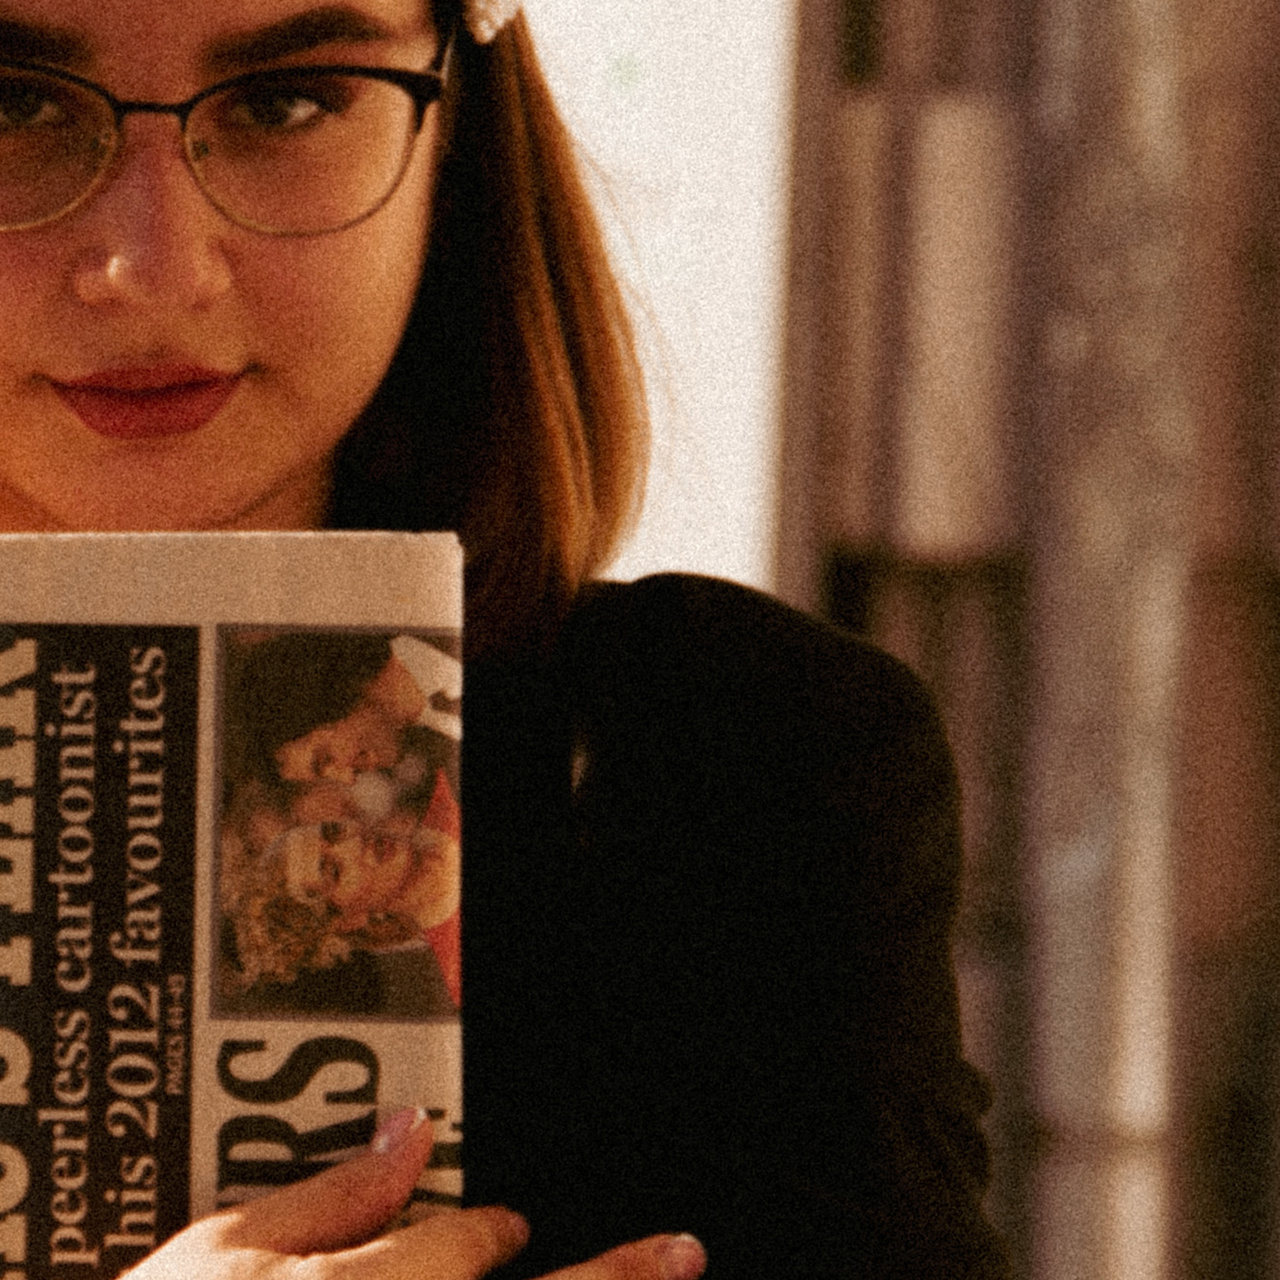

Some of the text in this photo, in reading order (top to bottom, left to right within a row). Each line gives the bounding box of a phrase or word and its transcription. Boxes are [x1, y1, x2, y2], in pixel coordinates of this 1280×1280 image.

[44, 663, 98, 994] cartoonist
[104, 645, 167, 1248] his 2012 favourites
[38, 1009, 100, 1267] peerless
[165, 1034, 186, 1096] PAGES
[215, 1036, 380, 1210] RS
